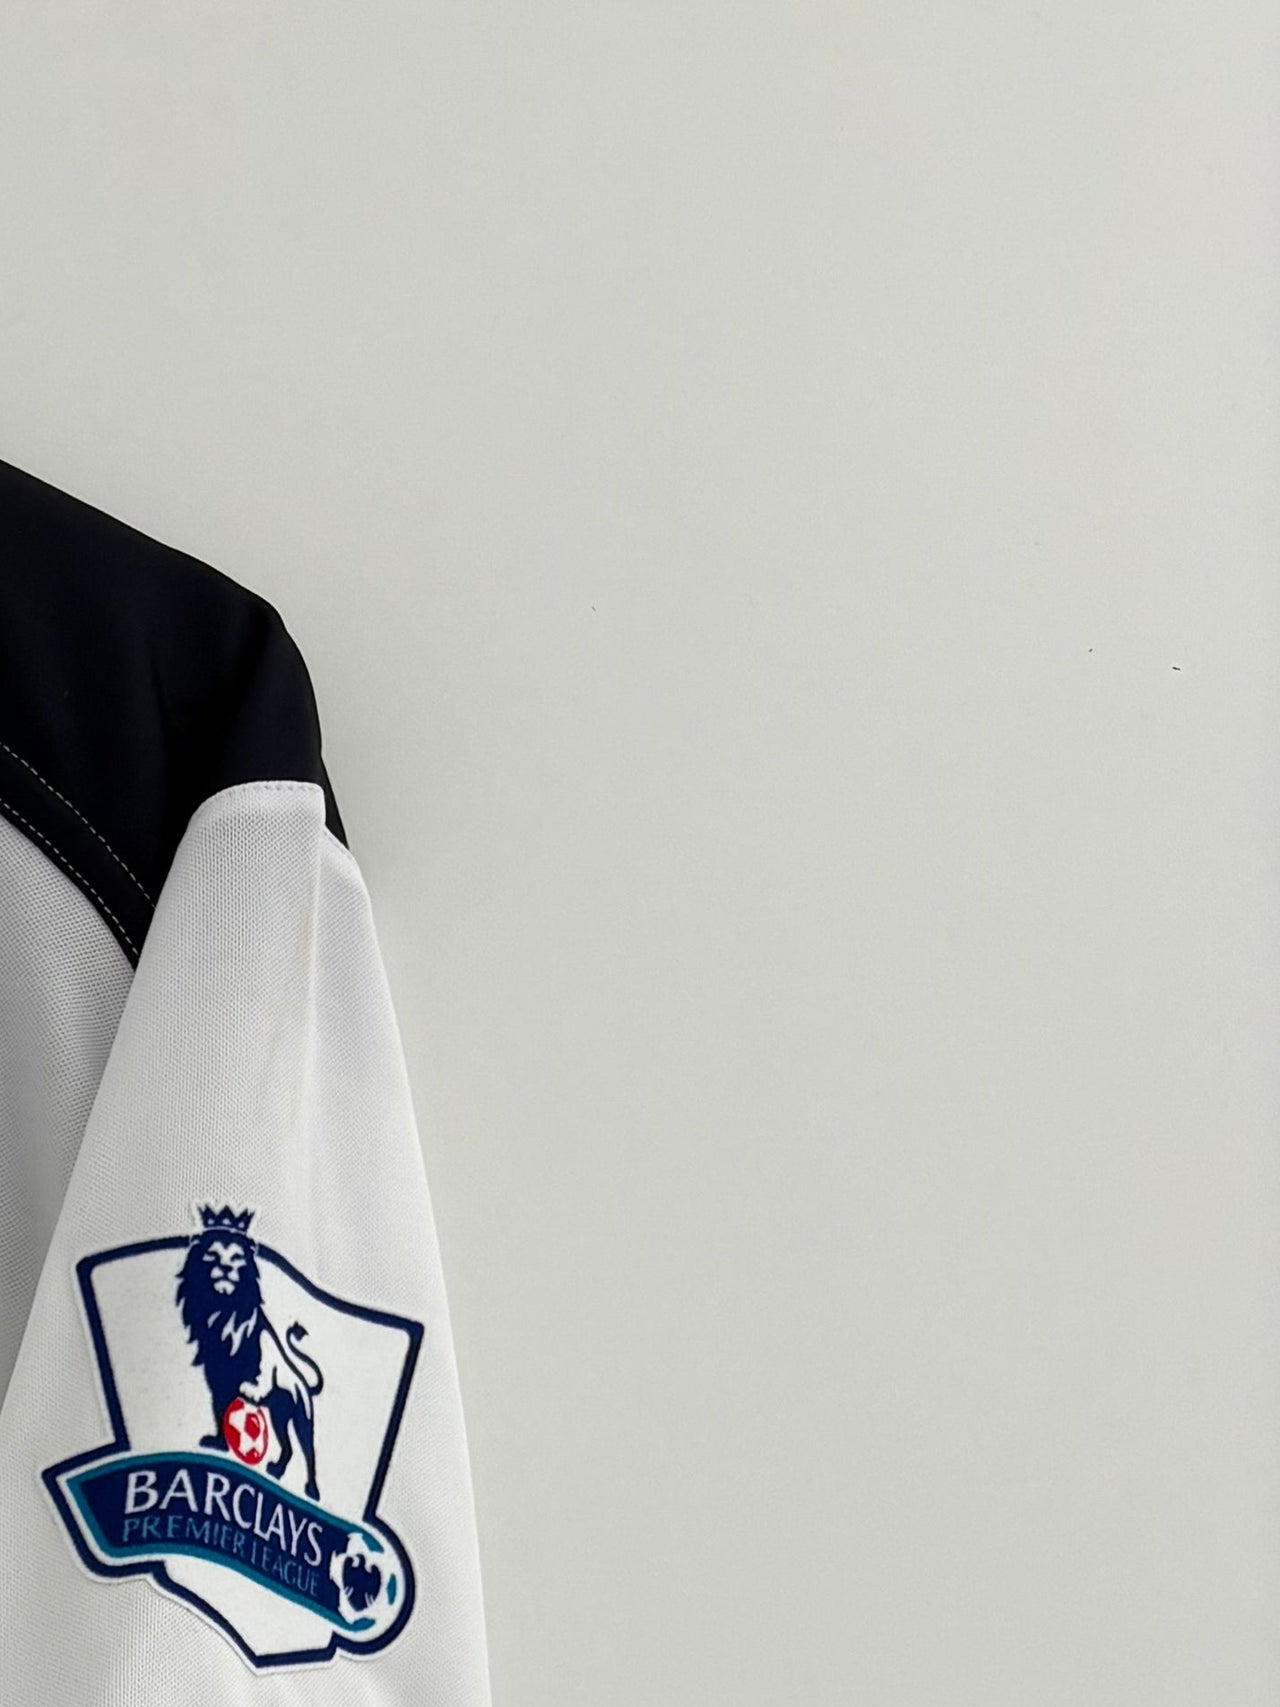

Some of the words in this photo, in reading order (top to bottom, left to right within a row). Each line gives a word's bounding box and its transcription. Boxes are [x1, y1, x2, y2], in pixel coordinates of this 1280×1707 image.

[122, 1515, 246, 1556] PREMIER
[251, 1540, 320, 1597] LEAGUE
[124, 1468, 323, 1567] BARCLAYS
